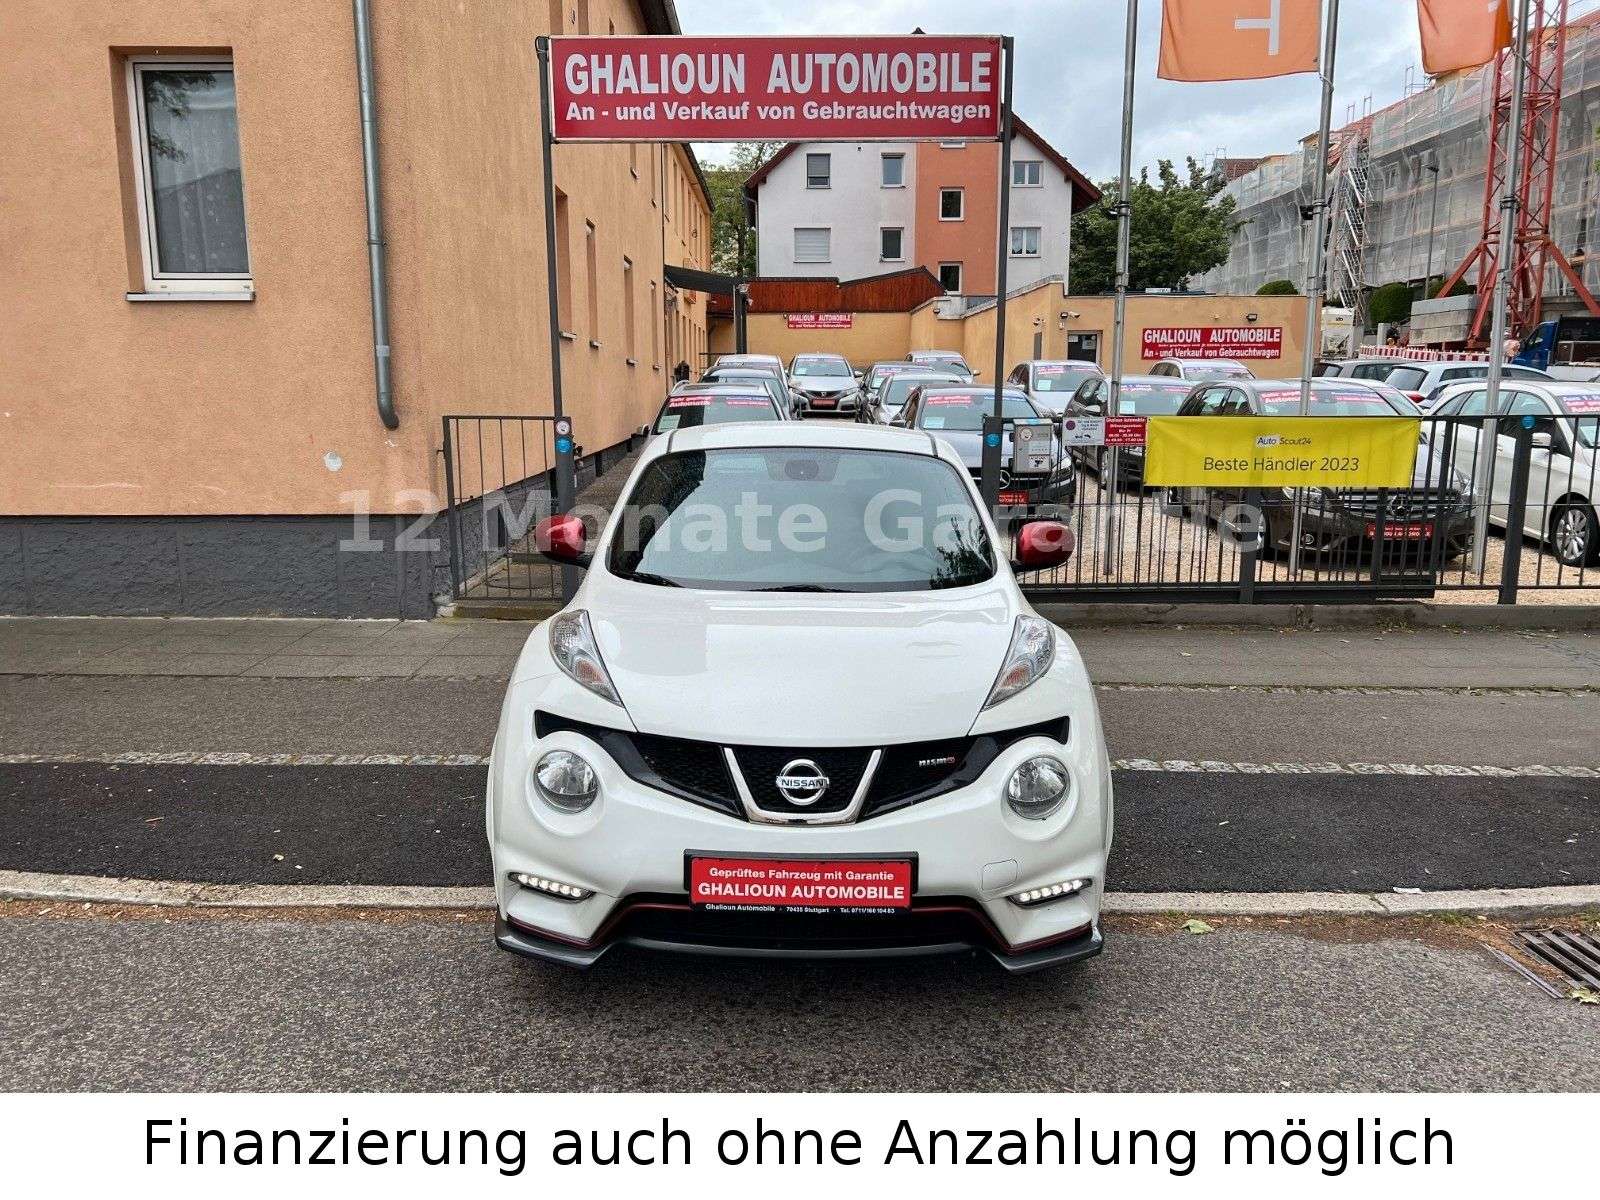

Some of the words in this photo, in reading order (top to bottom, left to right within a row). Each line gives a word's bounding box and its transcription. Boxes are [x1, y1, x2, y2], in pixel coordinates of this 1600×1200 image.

[565, 53, 745, 95] GHALIOUN
[766, 52, 992, 94] AUTOMOBILE
[565, 101, 596, 121] An
[615, 101, 656, 121] und
[662, 101, 750, 121] Verkauf
[757, 105, 796, 120] von
[802, 100, 991, 124] Gebrauchtwagen
[1144, 328, 1201, 343] GHALIOUN
[1209, 328, 1281, 343] AUTOMOBILE
[1143, 347, 1154, 357] An
[1159, 348, 1173, 357] und
[1175, 347, 1203, 357] Verkauf
[1204, 348, 1217, 357] von
[1218, 347, 1280, 358] Gebrauchtwagen
[1203, 456, 1249, 471] Beste
[1253, 456, 1317, 471] Händler
[1320, 457, 1360, 472] 2023
[781, 778, 825, 788] NISSAN
[709, 867, 766, 880] Geprüftes
[768, 869, 821, 882] Fahrzeug
[824, 870, 843, 881] mit
[845, 870, 895, 881] Garantie
[698, 882, 787, 898] GHALIOUN
[790, 885, 905, 900] AUTOMOBILE
[705, 903, 736, 911] Ghalioun
[736, 904, 776, 912] Automobile
